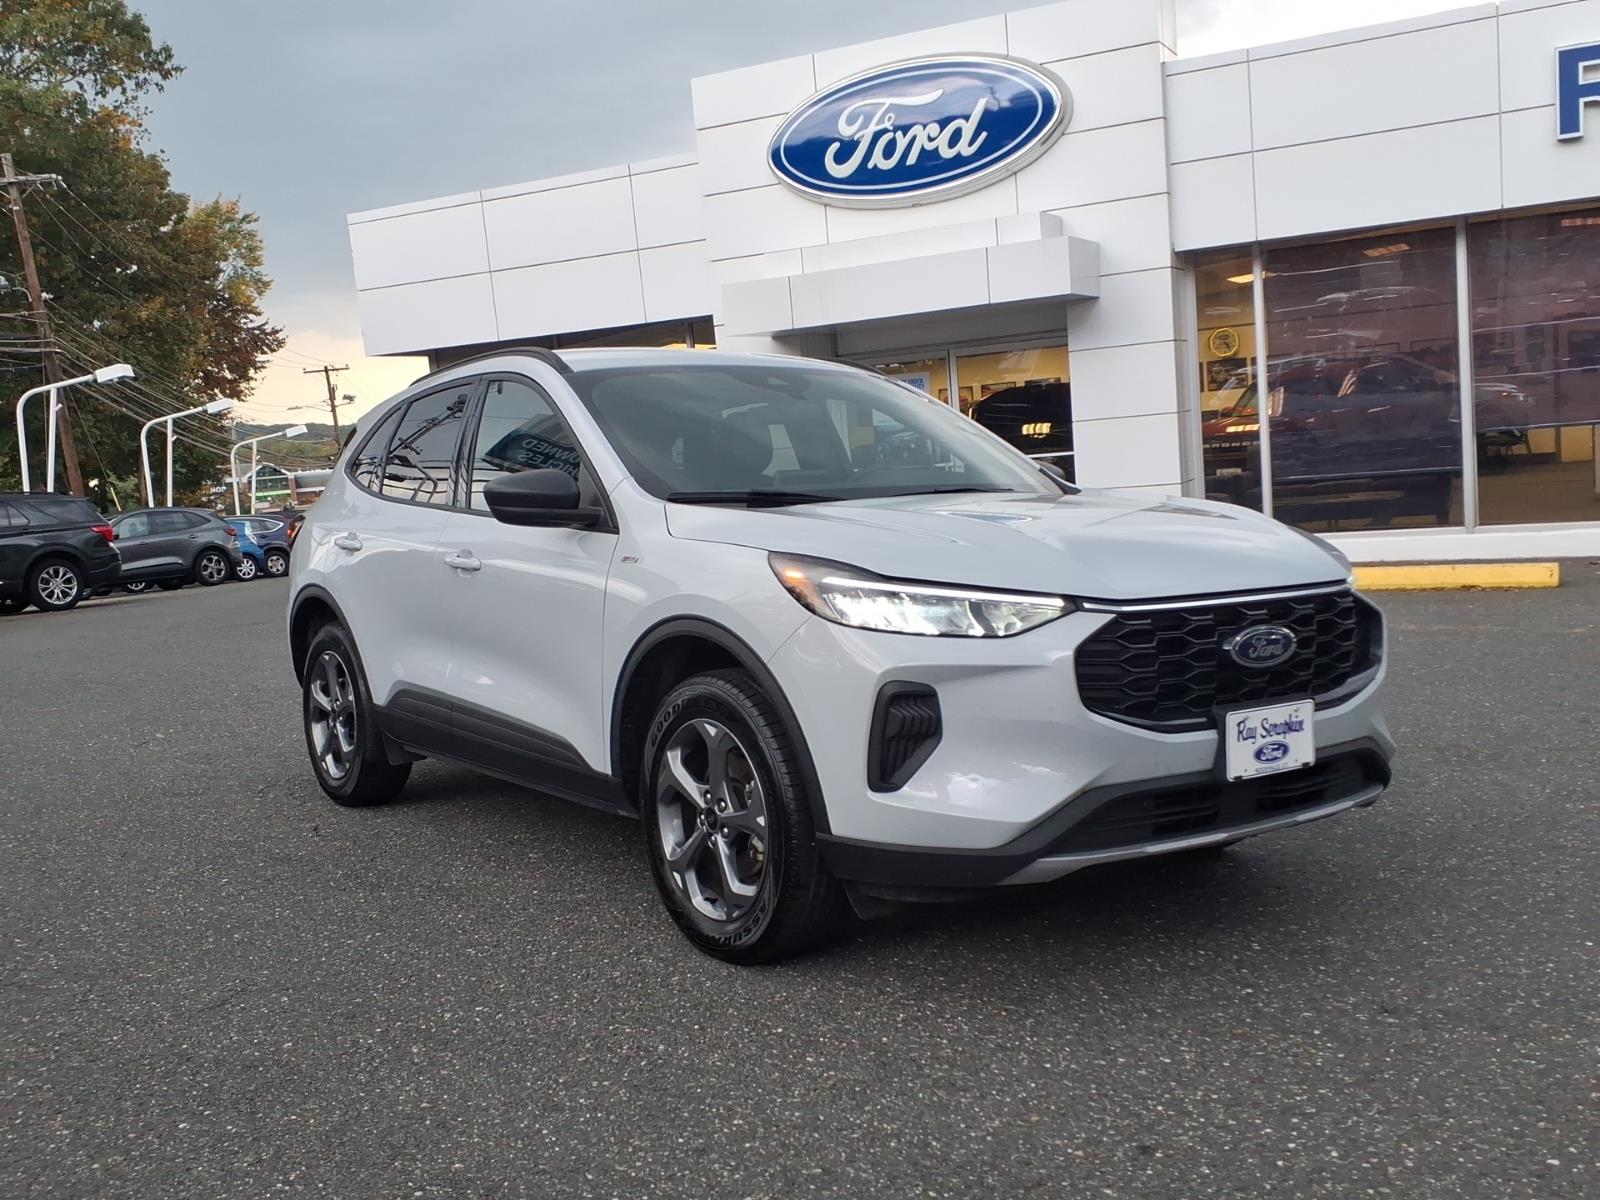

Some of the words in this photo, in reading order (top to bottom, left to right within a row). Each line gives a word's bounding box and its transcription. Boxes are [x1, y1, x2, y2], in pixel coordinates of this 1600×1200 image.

[825, 88, 989, 179] Ford
[1249, 635, 1284, 658] Ford
[1236, 717, 1257, 744] Ray
[1261, 744, 1285, 760] Ford
